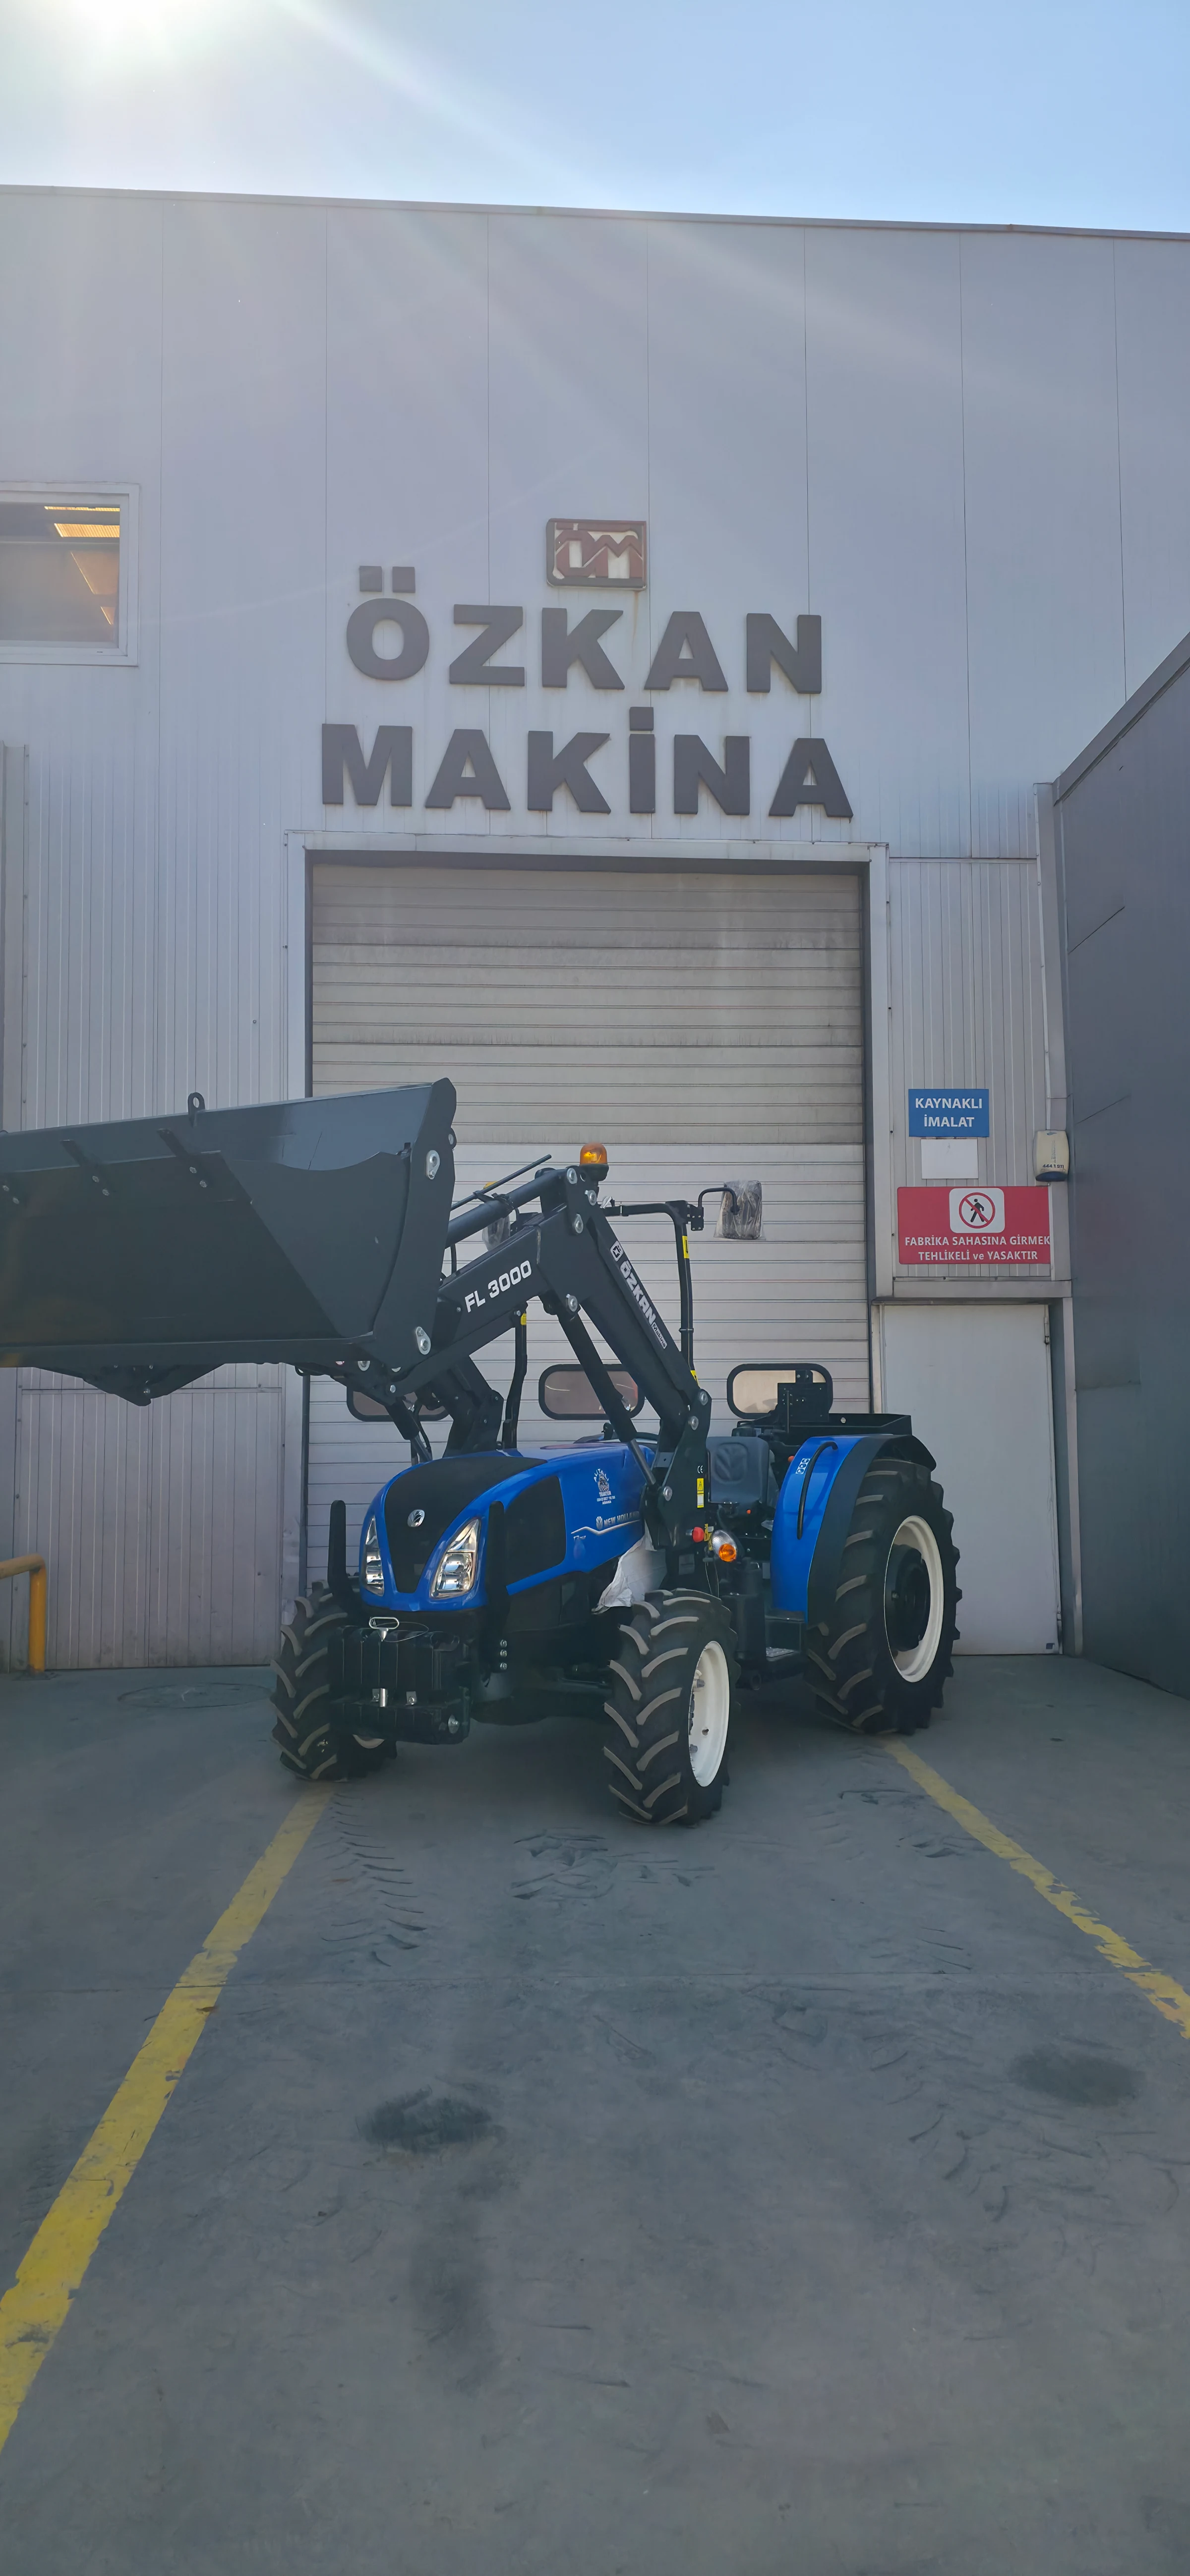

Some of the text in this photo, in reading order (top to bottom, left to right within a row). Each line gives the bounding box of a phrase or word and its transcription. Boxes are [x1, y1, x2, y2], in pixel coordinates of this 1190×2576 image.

[346, 566, 822, 694] ÖZKAN
[322, 707, 853, 818] MAKİNA
[915, 1098, 982, 1108] KAYNAKLI
[924, 1114, 975, 1127] İMALAT
[905, 1234, 1050, 1246] FABRİKA SAHASINA GİRMEK
[918, 1250, 970, 1260] TEHLİKELİ
[987, 1251, 1038, 1260] YASAKTIR
[465, 1260, 532, 1313] FL 3000
[620, 1260, 656, 1325] ÖZKAN
[652, 1323, 666, 1348] Makina
[604, 1516, 616, 1527] NEW
